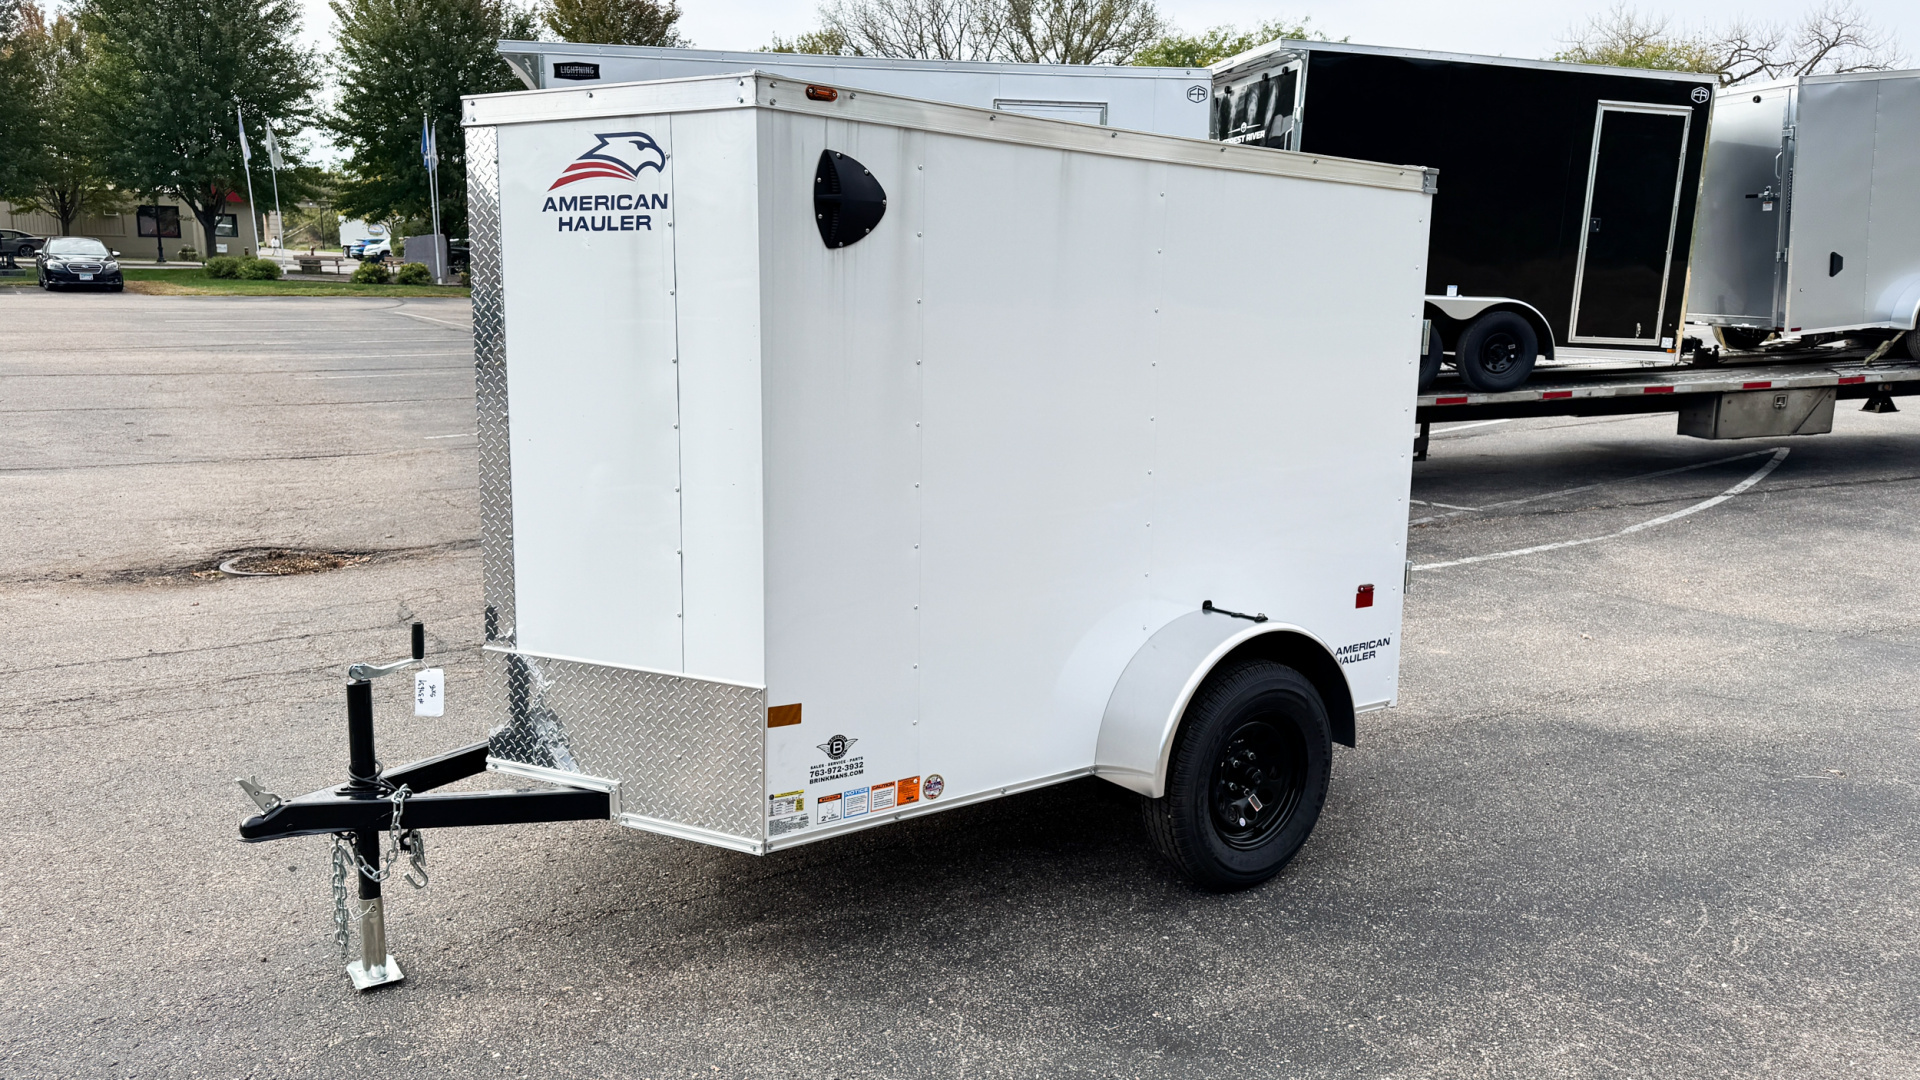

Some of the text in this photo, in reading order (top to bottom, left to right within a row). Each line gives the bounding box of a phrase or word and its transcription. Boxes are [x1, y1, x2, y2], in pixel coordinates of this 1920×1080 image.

[560, 65, 595, 74] LIGHTNING
[1246, 130, 1266, 142] RIVER
[542, 193, 668, 212] AMERICAN
[558, 215, 652, 232] HAULER
[1335, 637, 1391, 656] AMERICAN
[809, 761, 864, 778] 763-972-3932
[827, 759, 846, 767] SERVICE
[809, 769, 864, 785] BRINKMANS.COM
[844, 787, 868, 796] NOTICE
[871, 781, 895, 790] CAUTION
